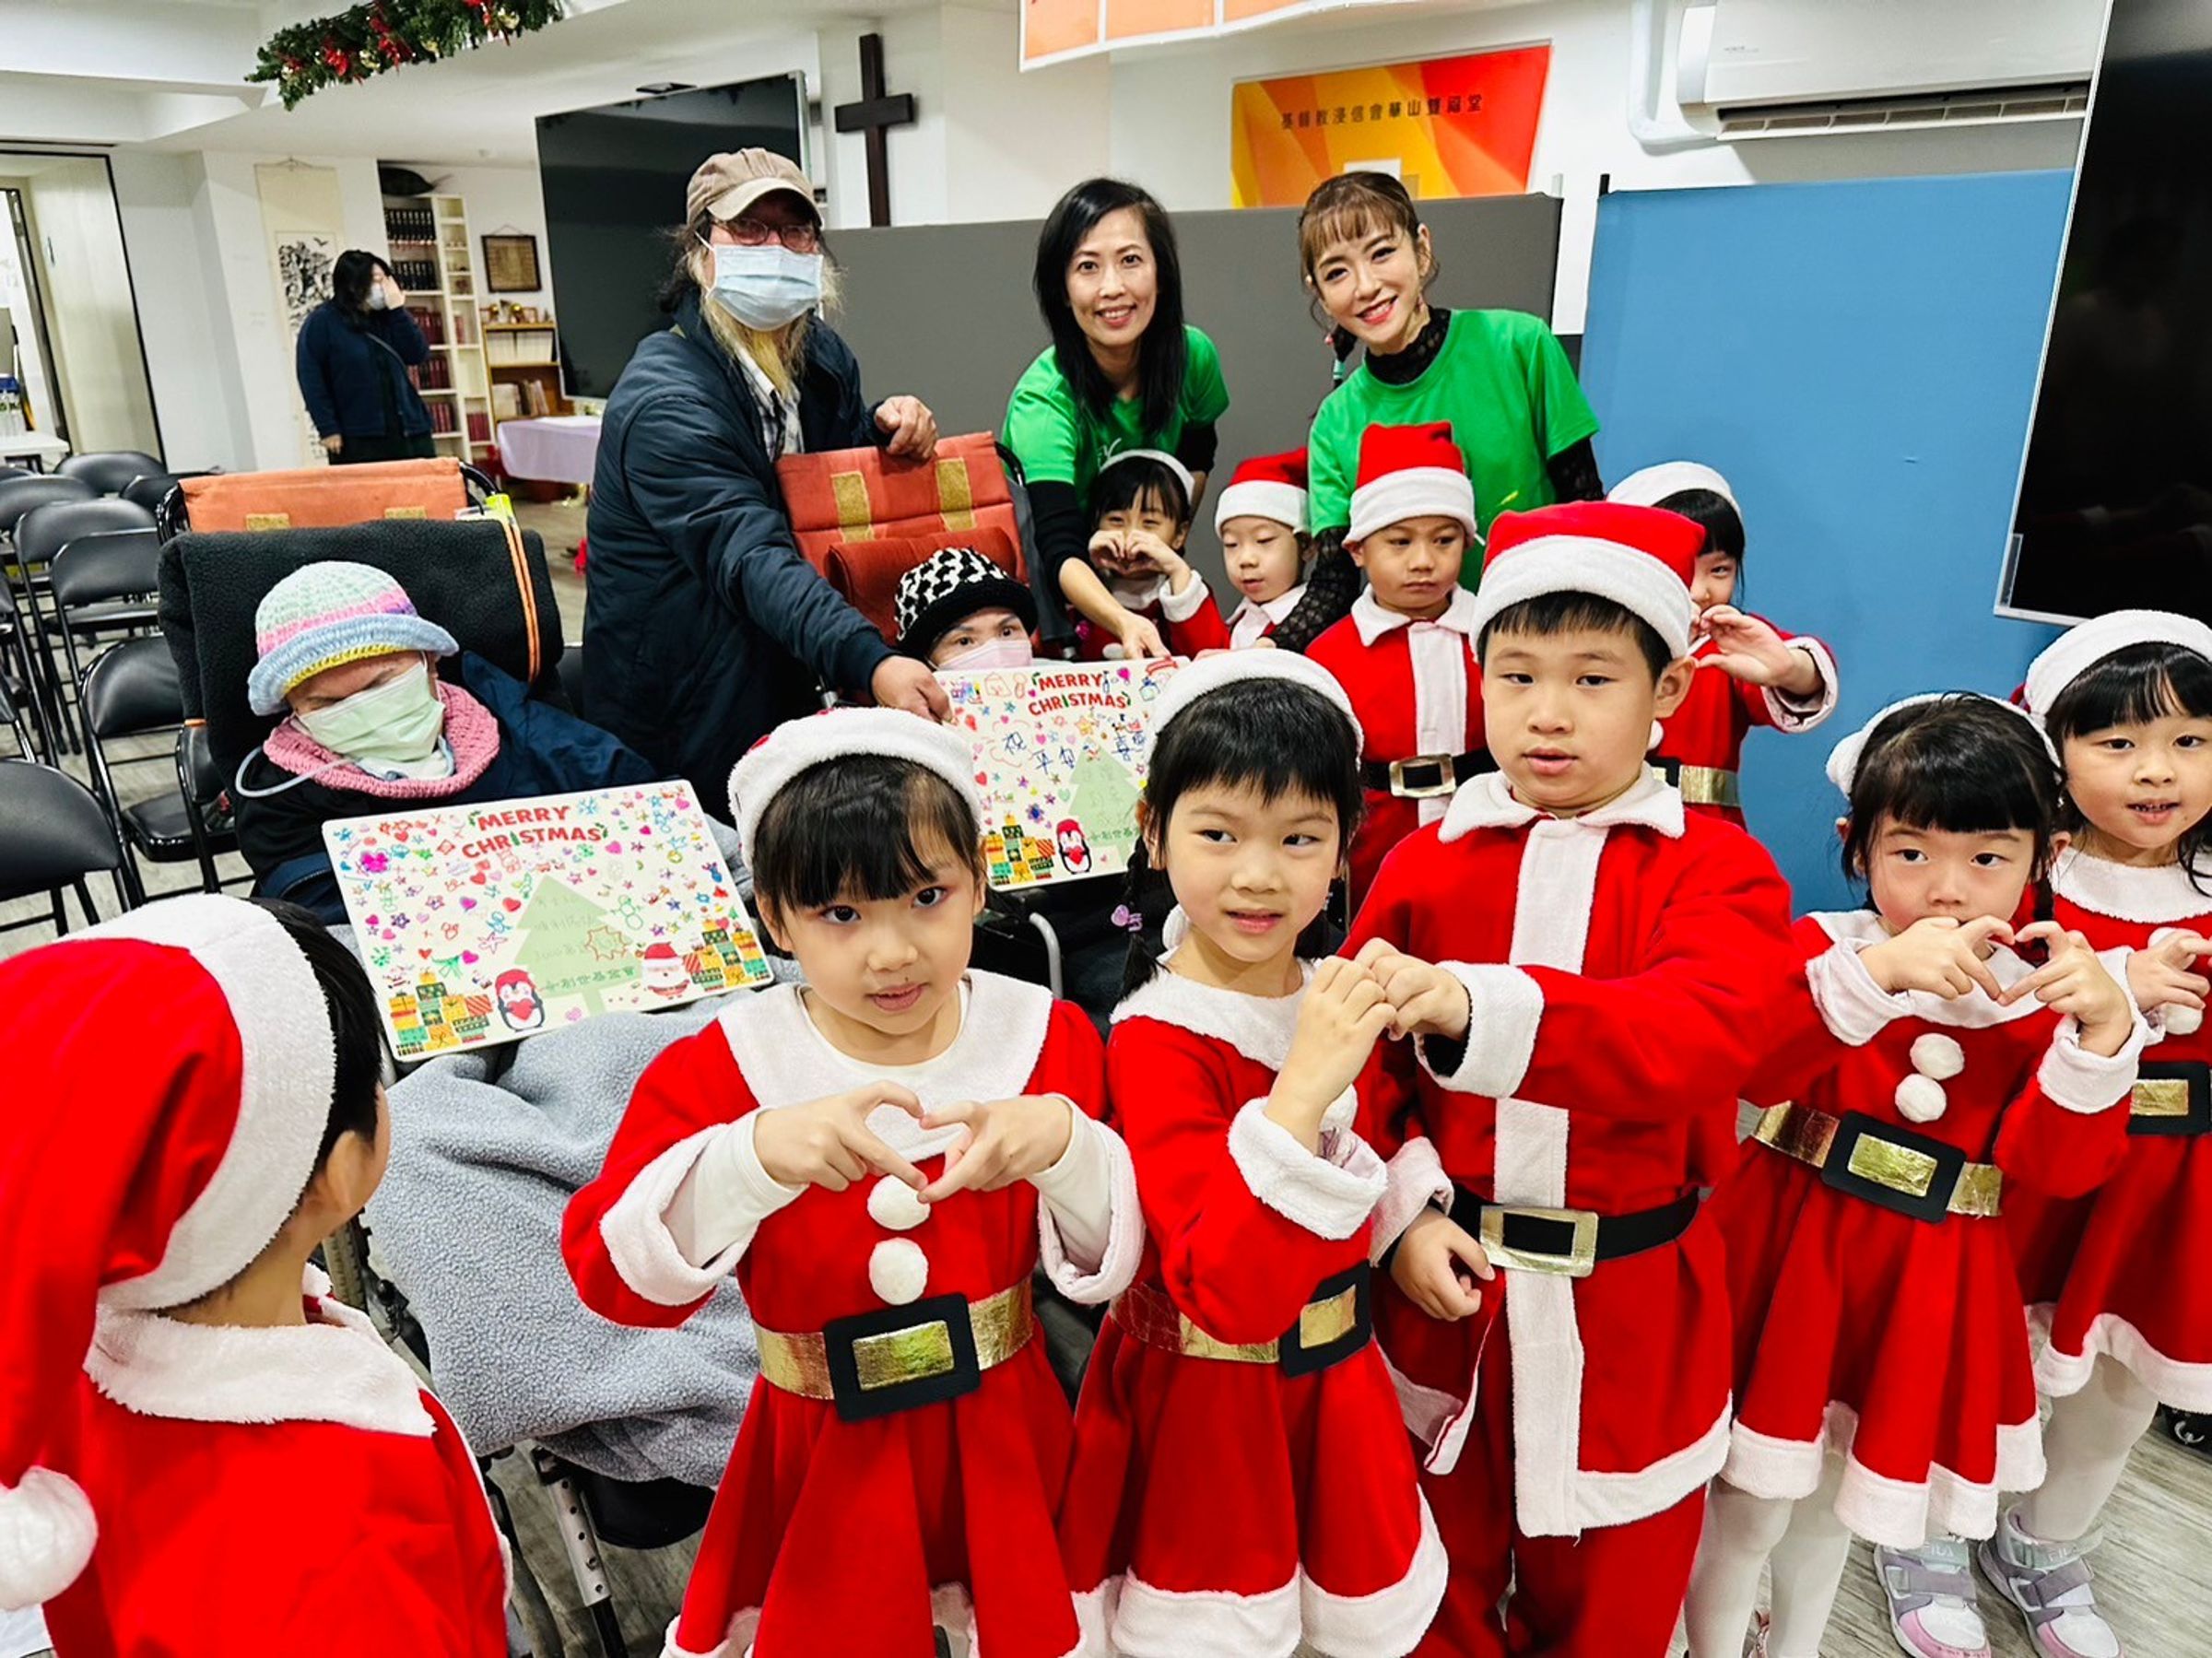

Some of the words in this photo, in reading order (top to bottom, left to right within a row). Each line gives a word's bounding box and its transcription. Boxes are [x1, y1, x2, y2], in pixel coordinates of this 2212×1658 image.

[1038, 673, 1103, 691] MERRY
[1028, 693, 1126, 716] CHRISTMAS
[477, 805, 571, 831] MERRY
[462, 828, 602, 858] CHRISTMAS
